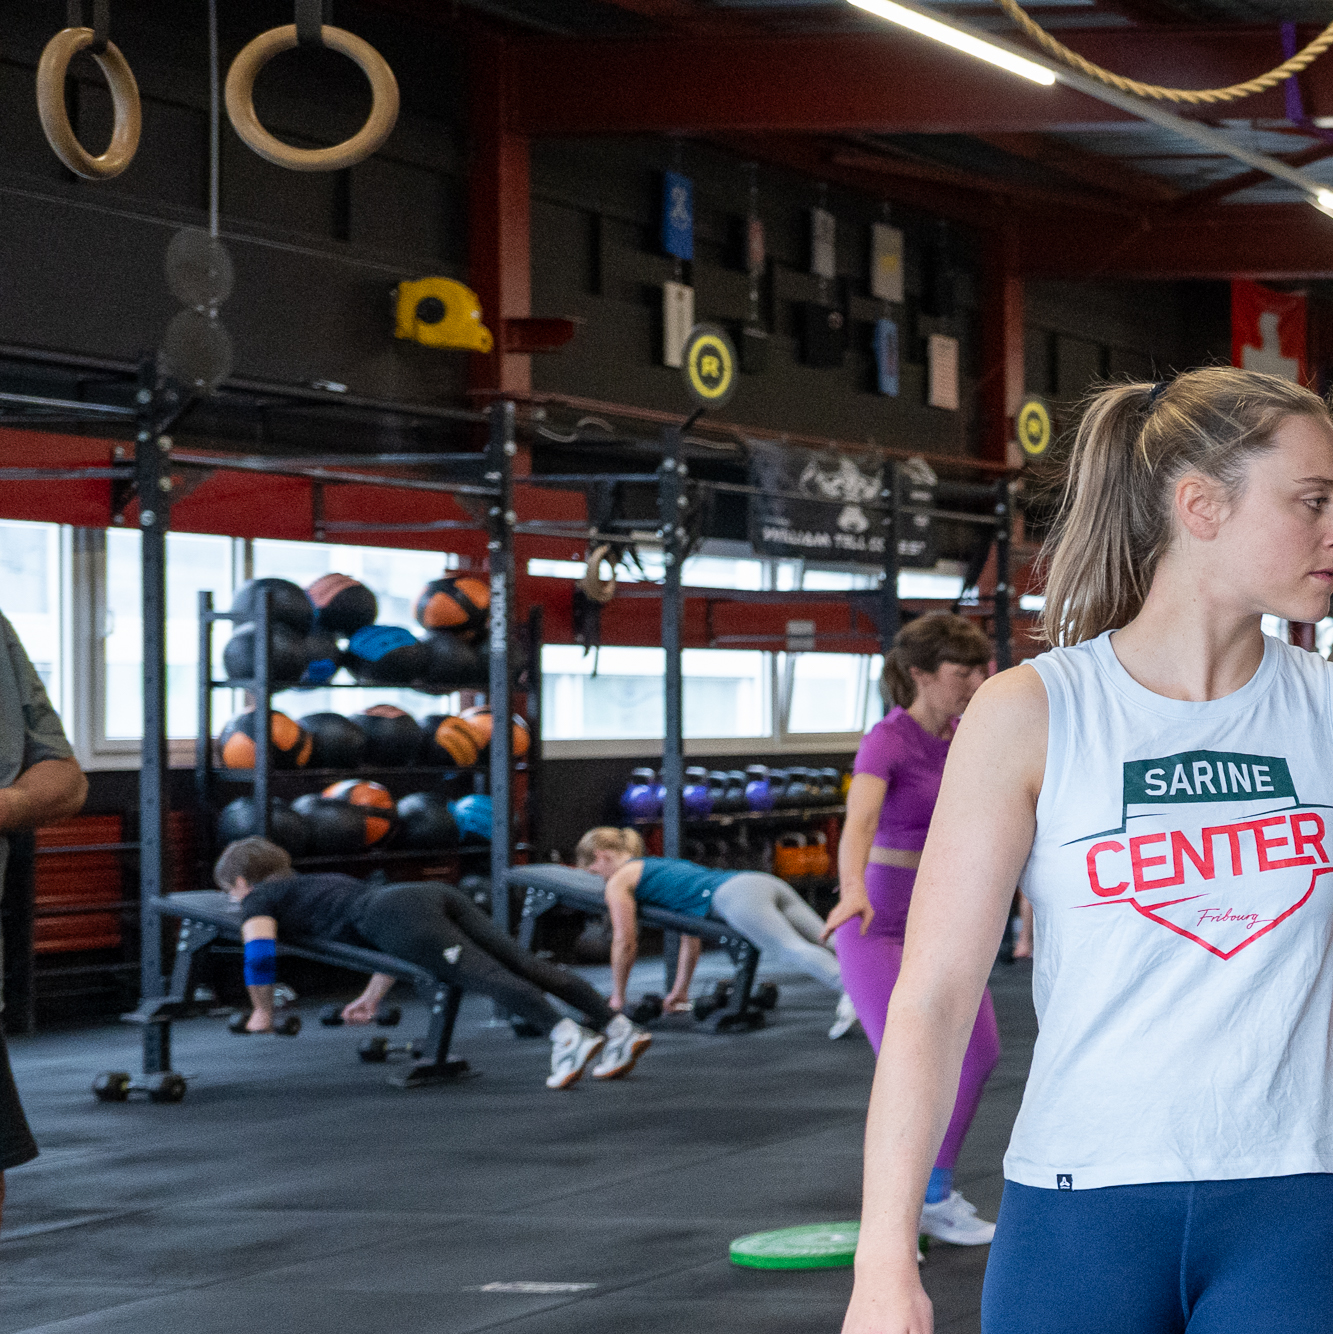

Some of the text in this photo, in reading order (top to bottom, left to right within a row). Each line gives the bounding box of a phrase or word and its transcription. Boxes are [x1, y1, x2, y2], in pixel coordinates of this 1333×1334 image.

[1144, 760, 1275, 796] SARINE
[1086, 812, 1330, 898] CENTER
[1196, 908, 1273, 930] Fribourg
